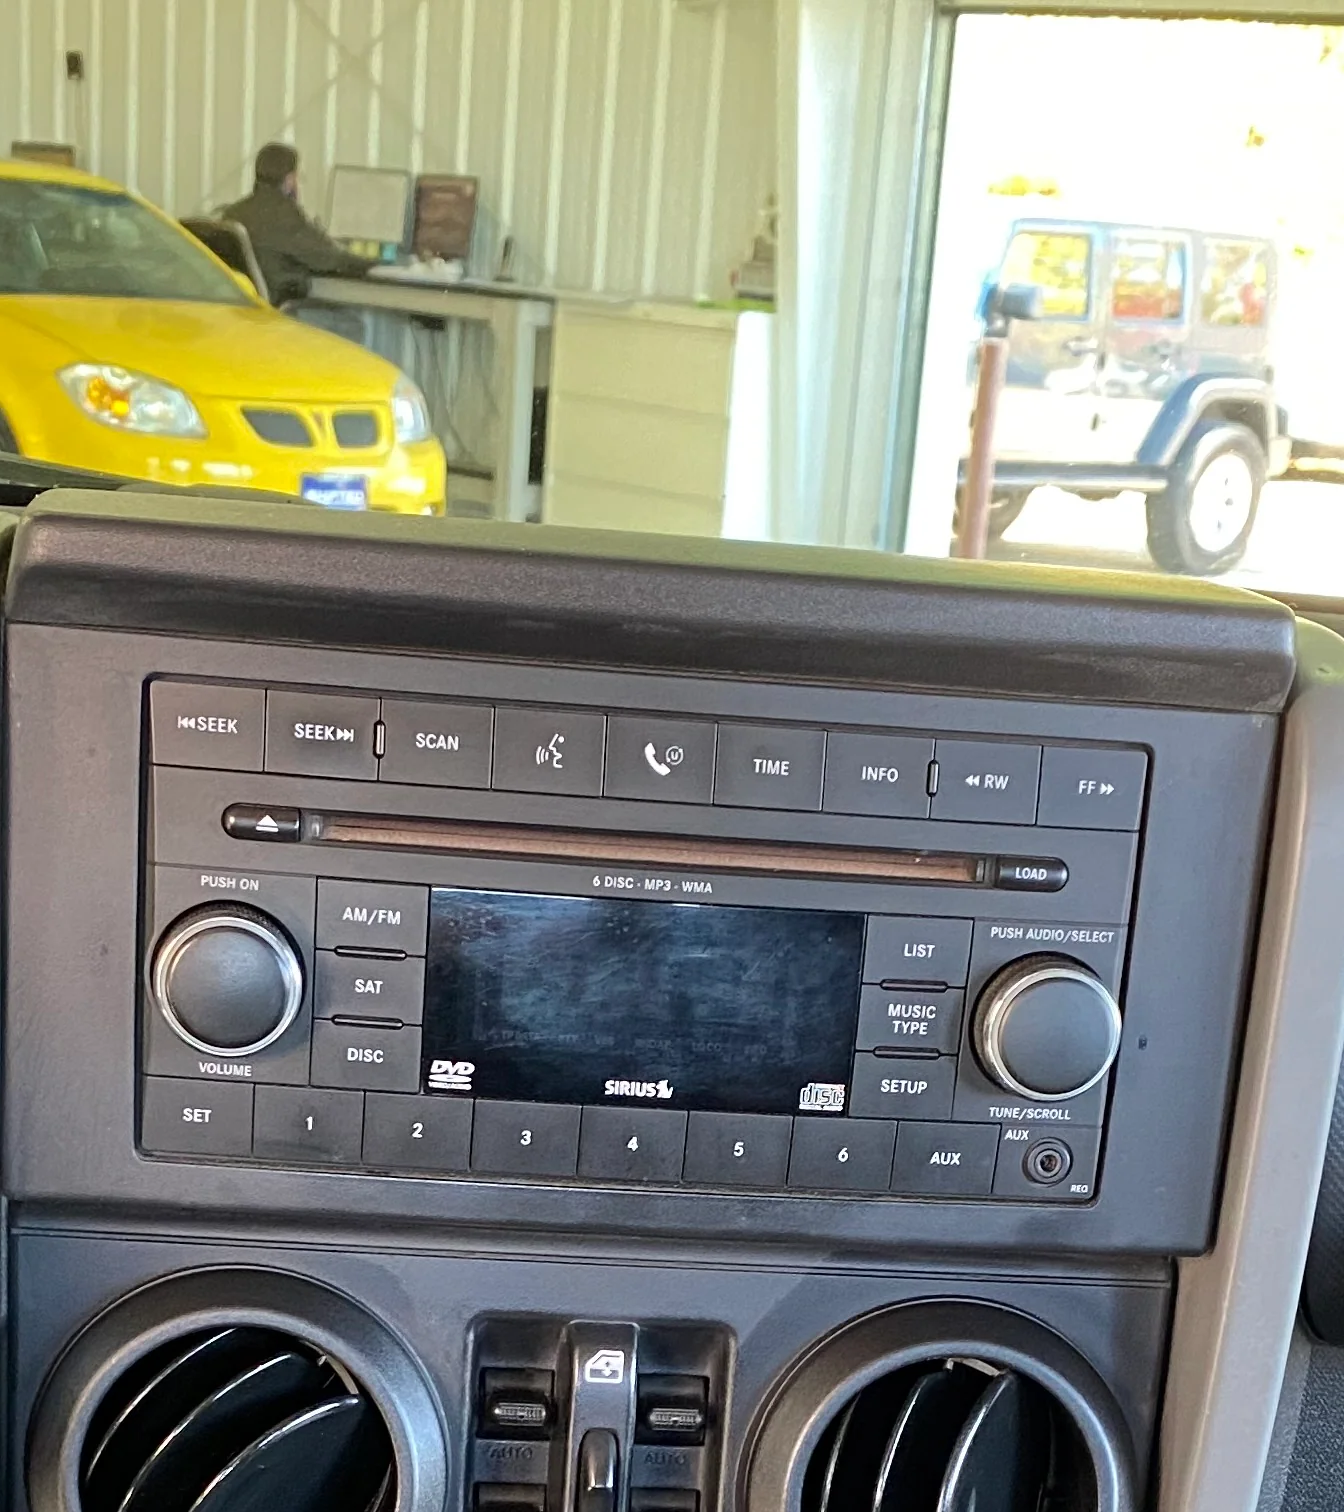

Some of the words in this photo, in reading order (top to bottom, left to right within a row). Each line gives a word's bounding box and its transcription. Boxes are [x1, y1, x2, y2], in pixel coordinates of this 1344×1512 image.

[197, 717, 237, 733] SEEK
[295, 724, 337, 740] SEEK
[416, 733, 458, 750] SCAN
[754, 759, 789, 775] TIME
[862, 767, 898, 782] INFO
[985, 775, 1008, 789] RW
[1079, 781, 1096, 794] FF
[1016, 867, 1047, 880] LOAD
[200, 875, 235, 890] PUSH
[240, 879, 258, 890] ON
[593, 876, 600, 886] 6
[605, 876, 633, 888] DISC
[645, 879, 671, 891] MP3
[682, 882, 712, 893] WMA
[343, 907, 400, 925] AM/FM
[991, 927, 1023, 938] PUSH
[1026, 929, 1114, 943] AUDIO/SELECT
[904, 944, 935, 957] LIST
[355, 979, 383, 993] SAT
[888, 1004, 936, 1020] MUSIC
[893, 1021, 928, 1034] TYPE
[348, 1048, 383, 1063] DISC
[199, 1062, 251, 1076] VOLUME
[430, 1060, 476, 1078] DVD
[604, 1080, 657, 1098] SIRIUS
[881, 1079, 927, 1094] SETUP
[183, 1108, 211, 1122] SET
[990, 1107, 1070, 1120] TUNE/SCROLL
[307, 1117, 312, 1130] 1
[412, 1123, 423, 1138] 2
[521, 1130, 531, 1145] 3
[1005, 1130, 1029, 1140] AUX
[628, 1137, 638, 1151] 4
[734, 1142, 743, 1156] 5
[838, 1148, 848, 1162] 6
[930, 1152, 961, 1165] AUX
